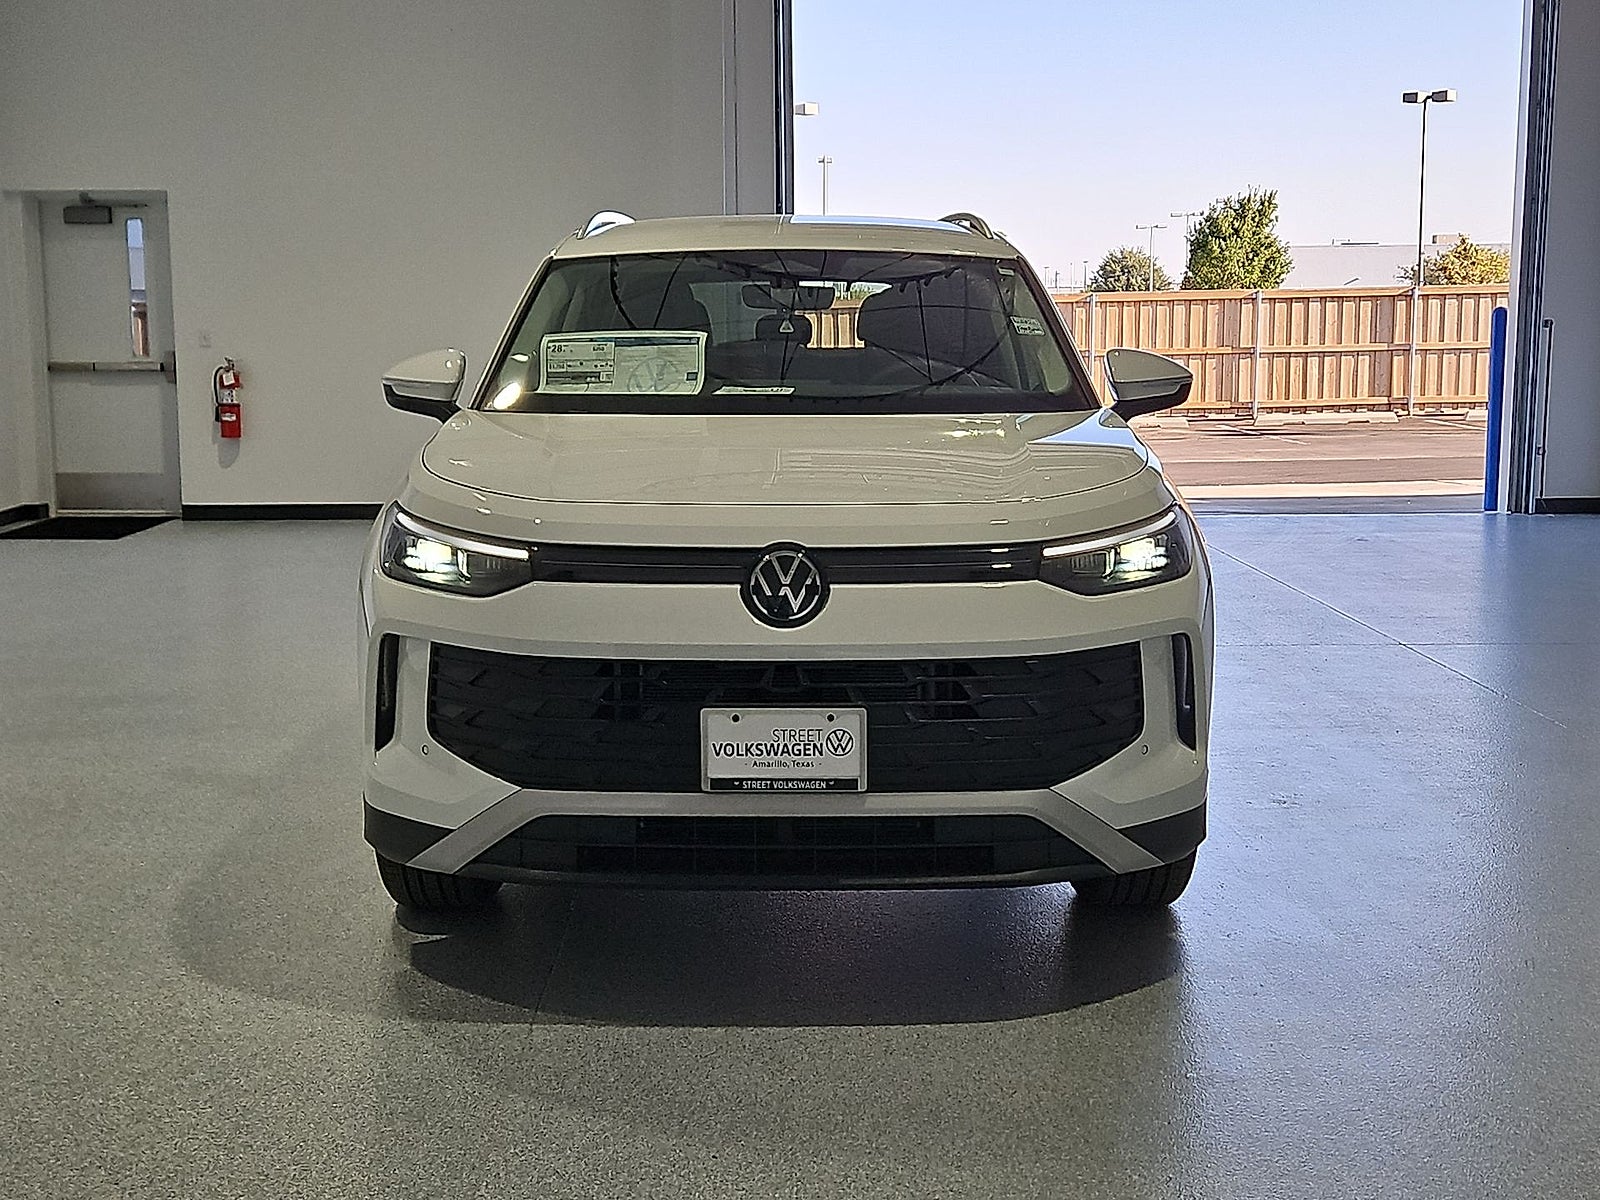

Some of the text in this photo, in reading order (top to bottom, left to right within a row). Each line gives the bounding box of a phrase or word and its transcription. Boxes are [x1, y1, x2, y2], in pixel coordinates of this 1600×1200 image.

[772, 728, 823, 743] STREET
[711, 742, 824, 757] VOLKSWAGEN
[751, 759, 815, 769] Amarillo, Texas
[742, 781, 827, 790] STREET VOLKSWAGEN
